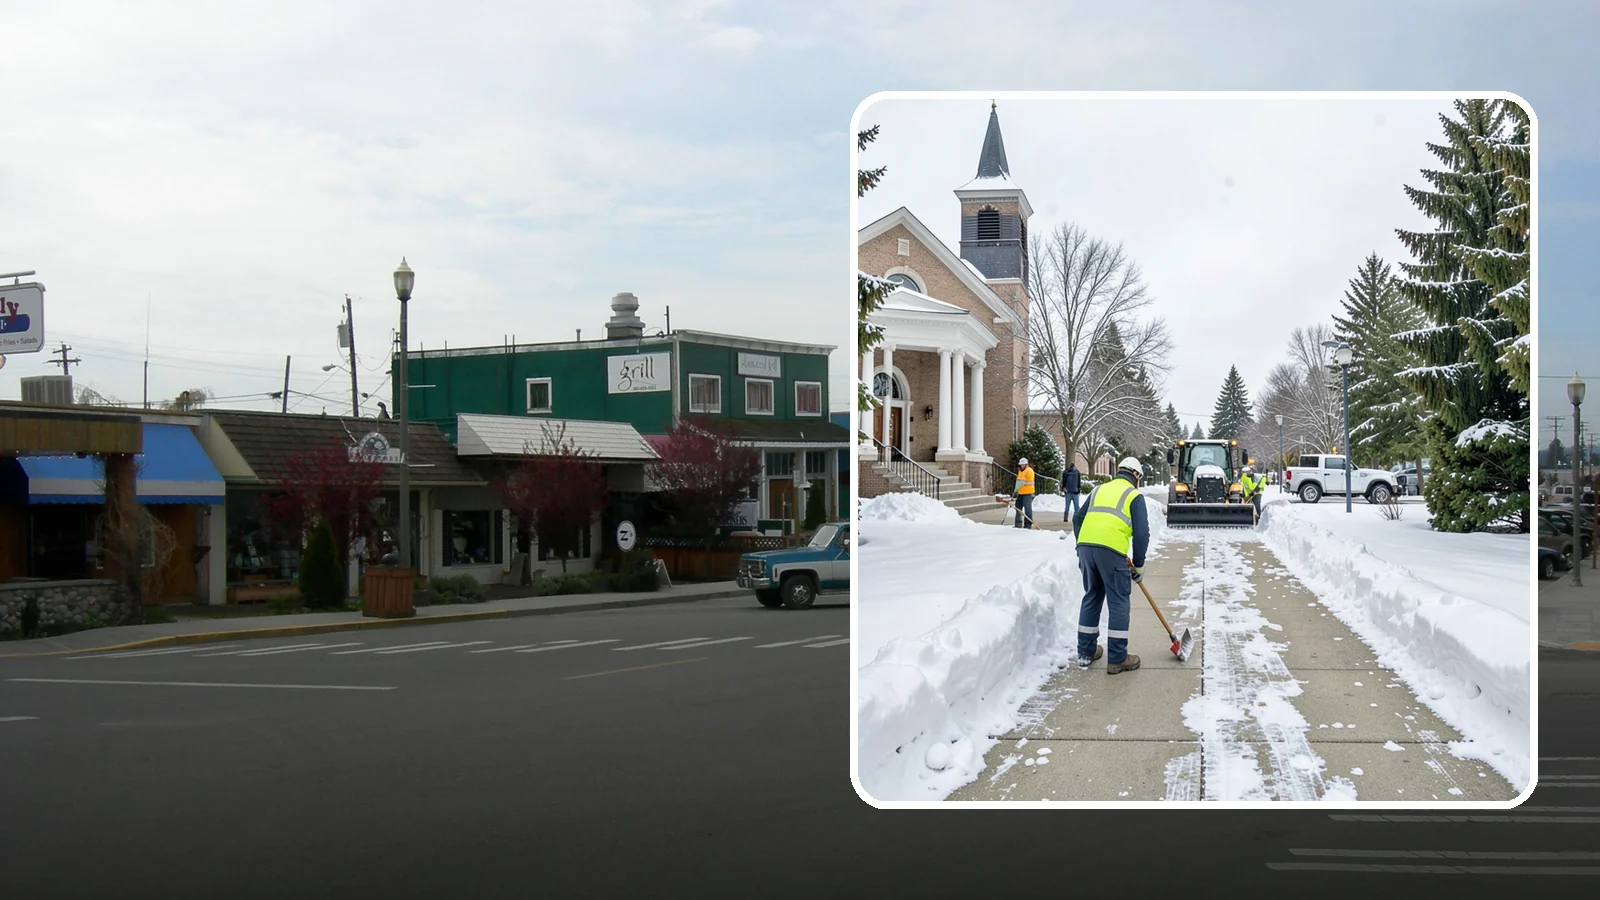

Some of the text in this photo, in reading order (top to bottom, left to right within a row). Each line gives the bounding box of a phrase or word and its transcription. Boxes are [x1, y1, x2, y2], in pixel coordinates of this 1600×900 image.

[3, 337, 38, 346] Fries Salads
[618, 356, 655, 391] grill
